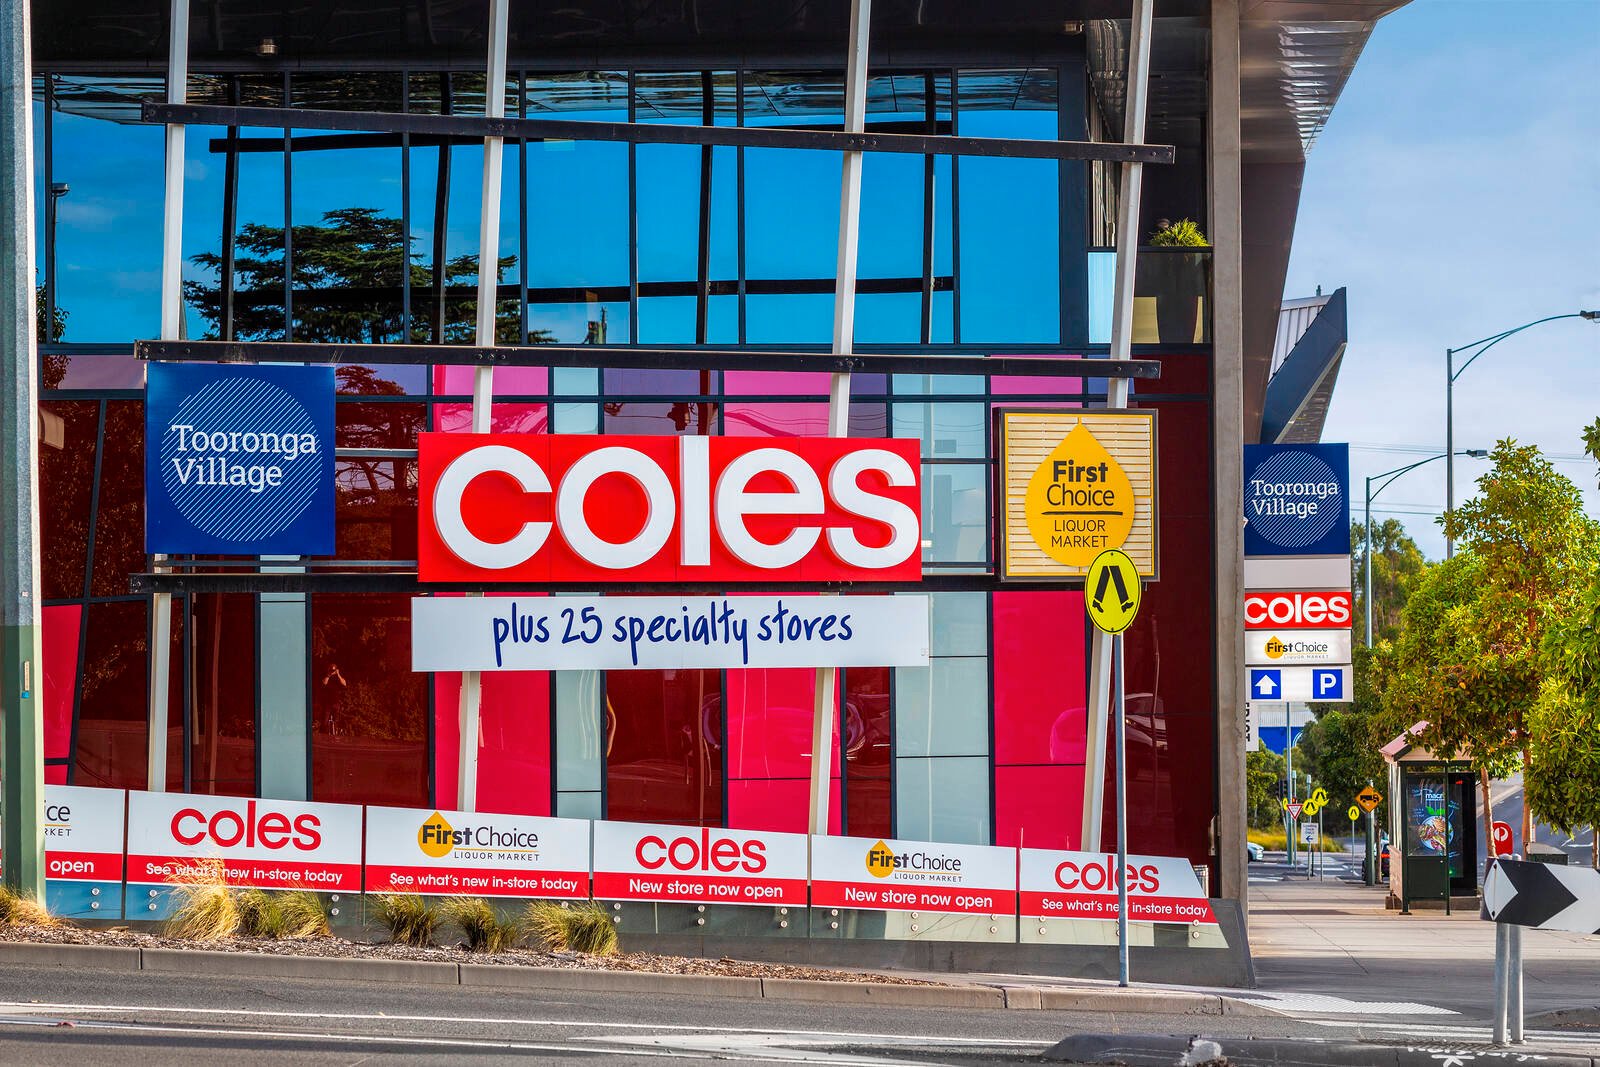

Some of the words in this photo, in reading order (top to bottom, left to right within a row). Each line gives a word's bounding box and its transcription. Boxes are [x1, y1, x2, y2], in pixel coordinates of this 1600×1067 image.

[172, 424, 317, 460] Tooronga
[172, 457, 282, 493] Village
[1053, 460, 1108, 482] First
[1047, 484, 1114, 506] Choice
[1251, 480, 1338, 498] Tooronga
[433, 435, 919, 569] coles
[1252, 499, 1318, 518] Village
[1054, 519, 1105, 532] LIQUOR
[1051, 536, 1108, 548] MARKET
[1244, 594, 1349, 624] coles
[493, 602, 550, 667] plus
[561, 607, 603, 644] 25
[612, 600, 749, 665] specialty
[758, 600, 853, 644] stores
[1267, 642, 1293, 652] First
[1294, 642, 1328, 652] Choice
[1320, 674, 1337, 695] P
[44, 800, 70, 821] ice
[171, 800, 321, 850] coles
[422, 824, 472, 845] First
[475, 826, 538, 848] Choice
[454, 852, 493, 860] LIQUOR
[498, 853, 540, 861] MARKET
[635, 828, 767, 873] coles
[869, 850, 909, 868] First
[912, 852, 962, 871] Choice
[50, 860, 94, 875] open
[146, 863, 171, 876] See
[175, 864, 218, 877] what's
[223, 867, 250, 879] new
[253, 866, 300, 880] in-store
[304, 869, 342, 885] today
[929, 874, 963, 882] MARKET
[1054, 855, 1160, 894] coles
[390, 872, 414, 885] See
[418, 874, 458, 886] what's
[462, 876, 488, 887] new
[492, 876, 538, 888] in-store
[541, 878, 578, 892] today
[630, 878, 663, 894] New
[667, 880, 704, 895] store
[708, 884, 740, 896] now
[744, 886, 783, 900] open
[845, 888, 877, 902] New
[882, 889, 917, 904] store
[921, 894, 952, 906] now
[956, 895, 992, 908] open
[1042, 898, 1064, 910] See
[1066, 900, 1102, 912] what's
[1106, 902, 1126, 912] ne
[1132, 904, 1172, 915] in-store
[1175, 904, 1208, 917] today
